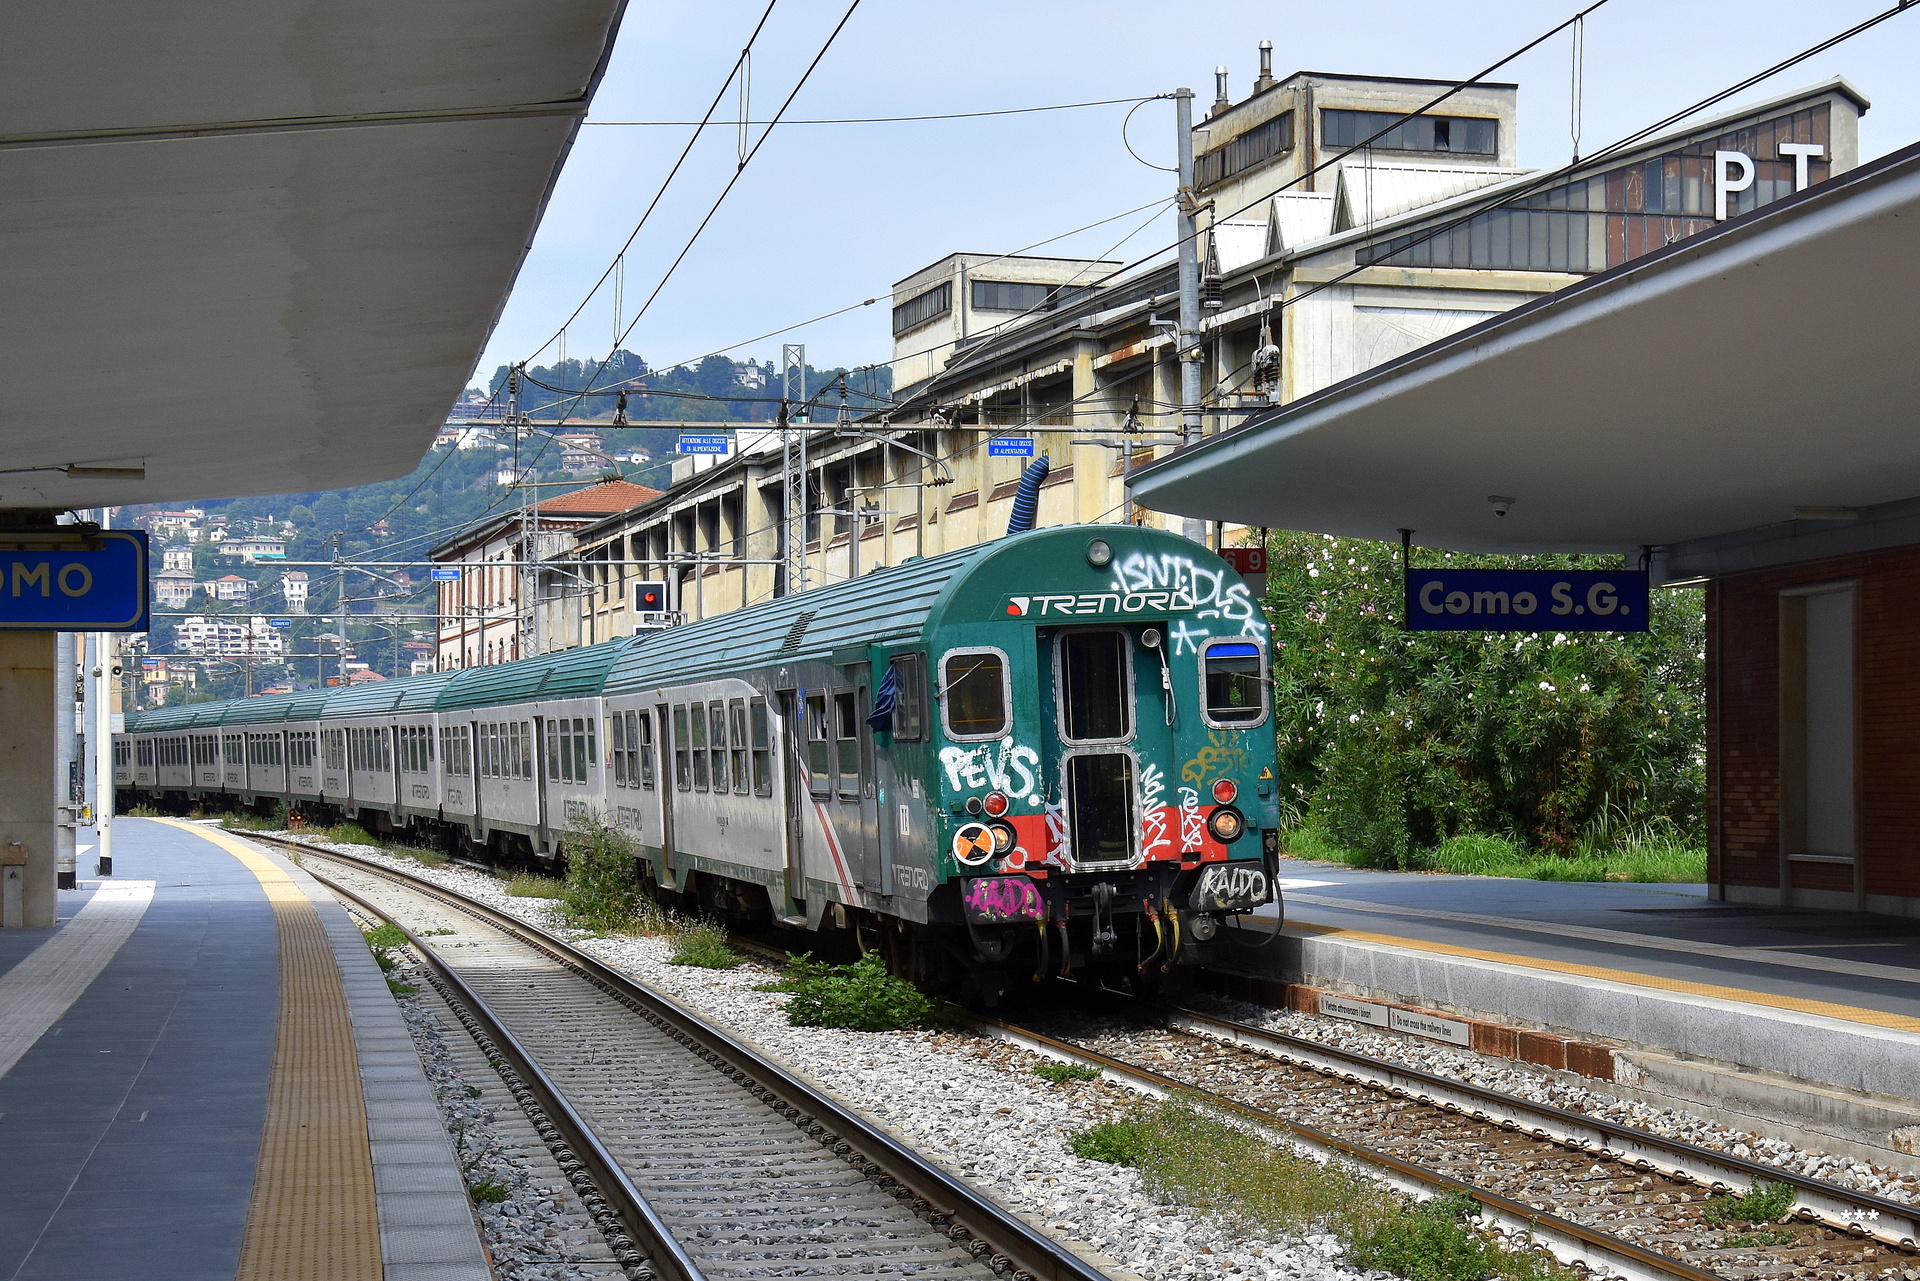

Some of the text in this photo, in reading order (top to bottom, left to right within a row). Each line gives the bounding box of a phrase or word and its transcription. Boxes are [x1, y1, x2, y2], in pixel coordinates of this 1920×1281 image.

[1715, 142, 1824, 221] P T
[1249, 551, 1262, 570] 9
[0, 562, 93, 598] MO
[1032, 592, 1196, 616] TRENORD
[1419, 580, 1631, 616] Como S.G.
[896, 864, 929, 891] TRENORD
[1396, 1014, 1402, 1026] Do
[1410, 1020, 1419, 1030] cross
[1427, 1021, 1442, 1037] railway
[1442, 1023, 1452, 1037] lines
